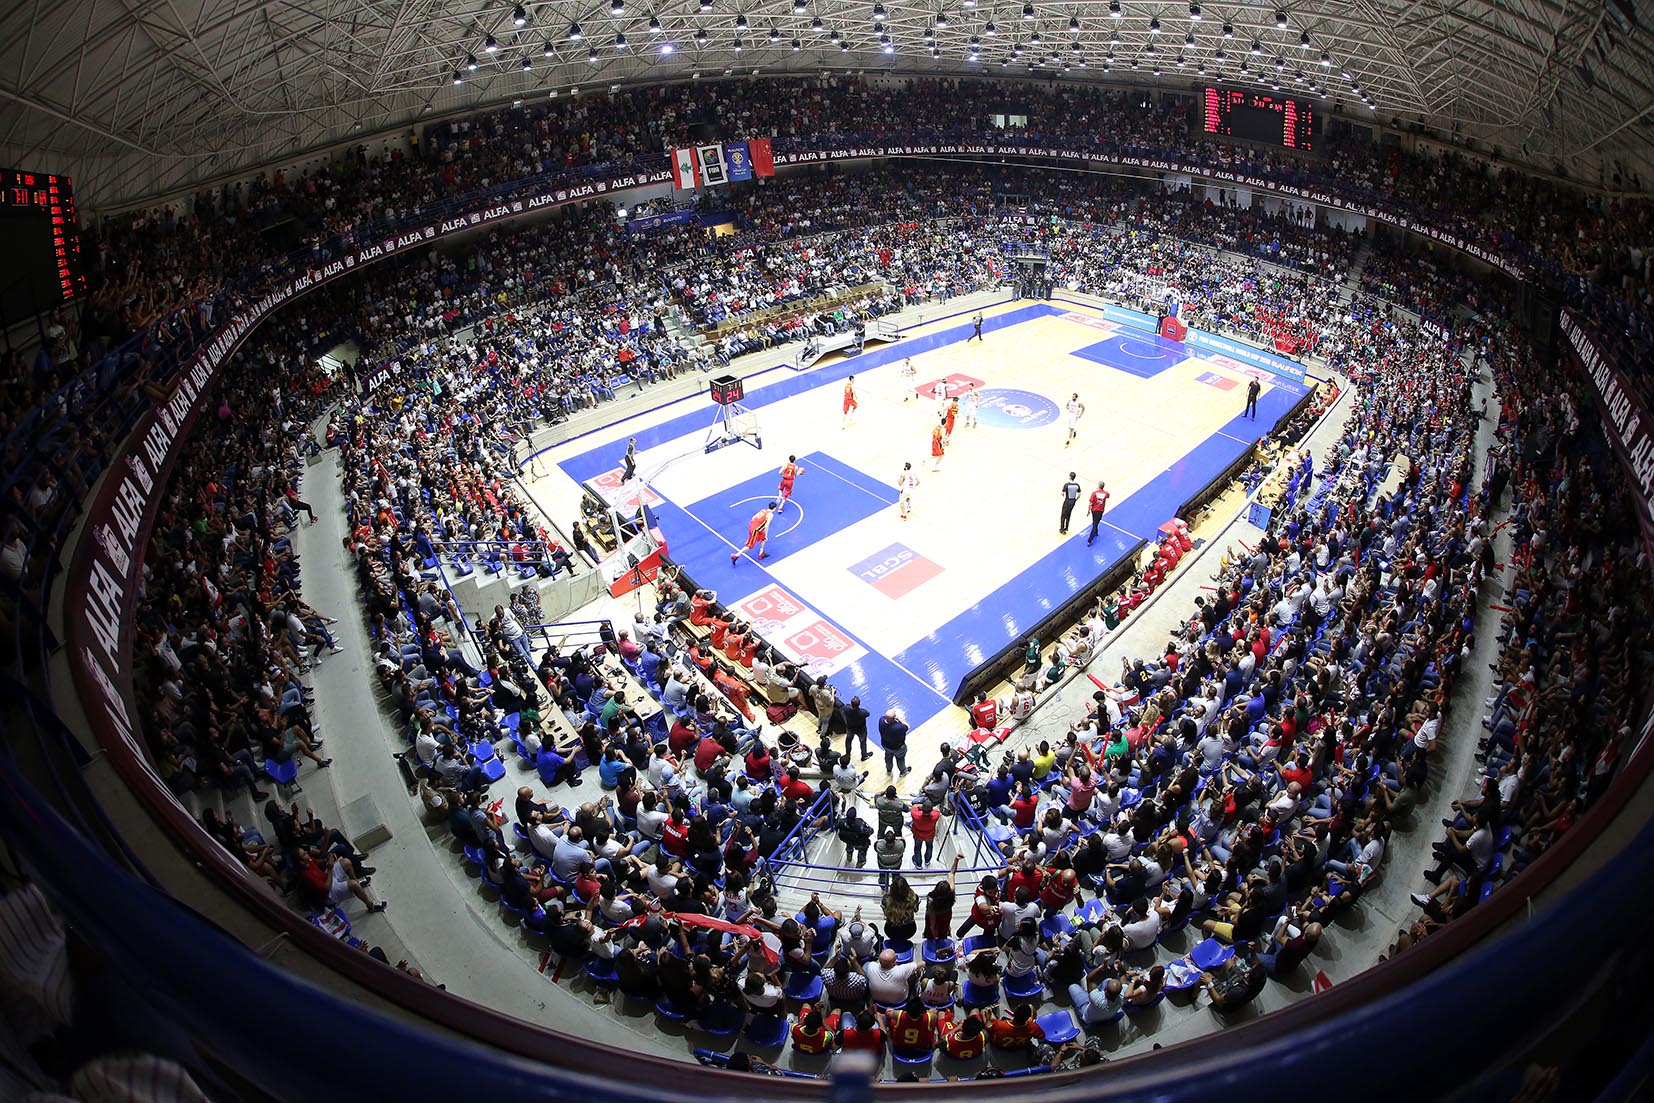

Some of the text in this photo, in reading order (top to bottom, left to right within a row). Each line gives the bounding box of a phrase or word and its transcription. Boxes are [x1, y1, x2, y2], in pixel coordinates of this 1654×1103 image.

[773, 156, 787, 164] LFA
[799, 152, 818, 161] ALFA
[887, 147, 904, 155] ALFA
[998, 146, 1017, 154] ALFA
[1061, 151, 1080, 159] ALFA
[1090, 154, 1110, 162] ALFA
[1121, 158, 1140, 166] ALFA
[1151, 161, 1169, 170] ALFA
[1182, 165, 1201, 175] ALFA
[1215, 171, 1234, 181] ALFA
[1246, 177, 1265, 188] ALFA
[1279, 185, 1299, 196] ALFA
[1311, 193, 1331, 204] ALFA
[1378, 212, 1398, 224] ALFA
[1410, 223, 1430, 236] ALFA
[1439, 232, 1456, 246] ALFA
[1465, 243, 1481, 257] ALFA
[1002, 216, 1023, 224] ALFA
[1423, 320, 1440, 337] ALFA
[369, 369, 391, 392] ALFA
[726, 389, 740, 404] 24
[1593, 360, 1611, 396] ALFA
[1609, 388, 1632, 433] ALFA
[84, 558, 124, 674] ALFA
[112, 476, 146, 551] ALFA
[143, 422, 171, 473] ALFA
[169, 389, 191, 426] ALFA
[190, 362, 209, 392] ALFA
[295, 277, 313, 291] ALFA
[324, 260, 344, 278] ALFA
[359, 245, 383, 263] ALFA
[397, 231, 423, 248] ALFA
[441, 217, 467, 234] ALFA
[484, 206, 510, 221] ALFA
[528, 194, 555, 208] ALFA
[569, 185, 594, 198] ALFA
[612, 177, 636, 189] ALFA
[650, 170, 673, 182] ALFA
[1139, 670, 1148, 682] 2
[1023, 701, 1029, 710] 6
[904, 1028, 919, 1044] 9
